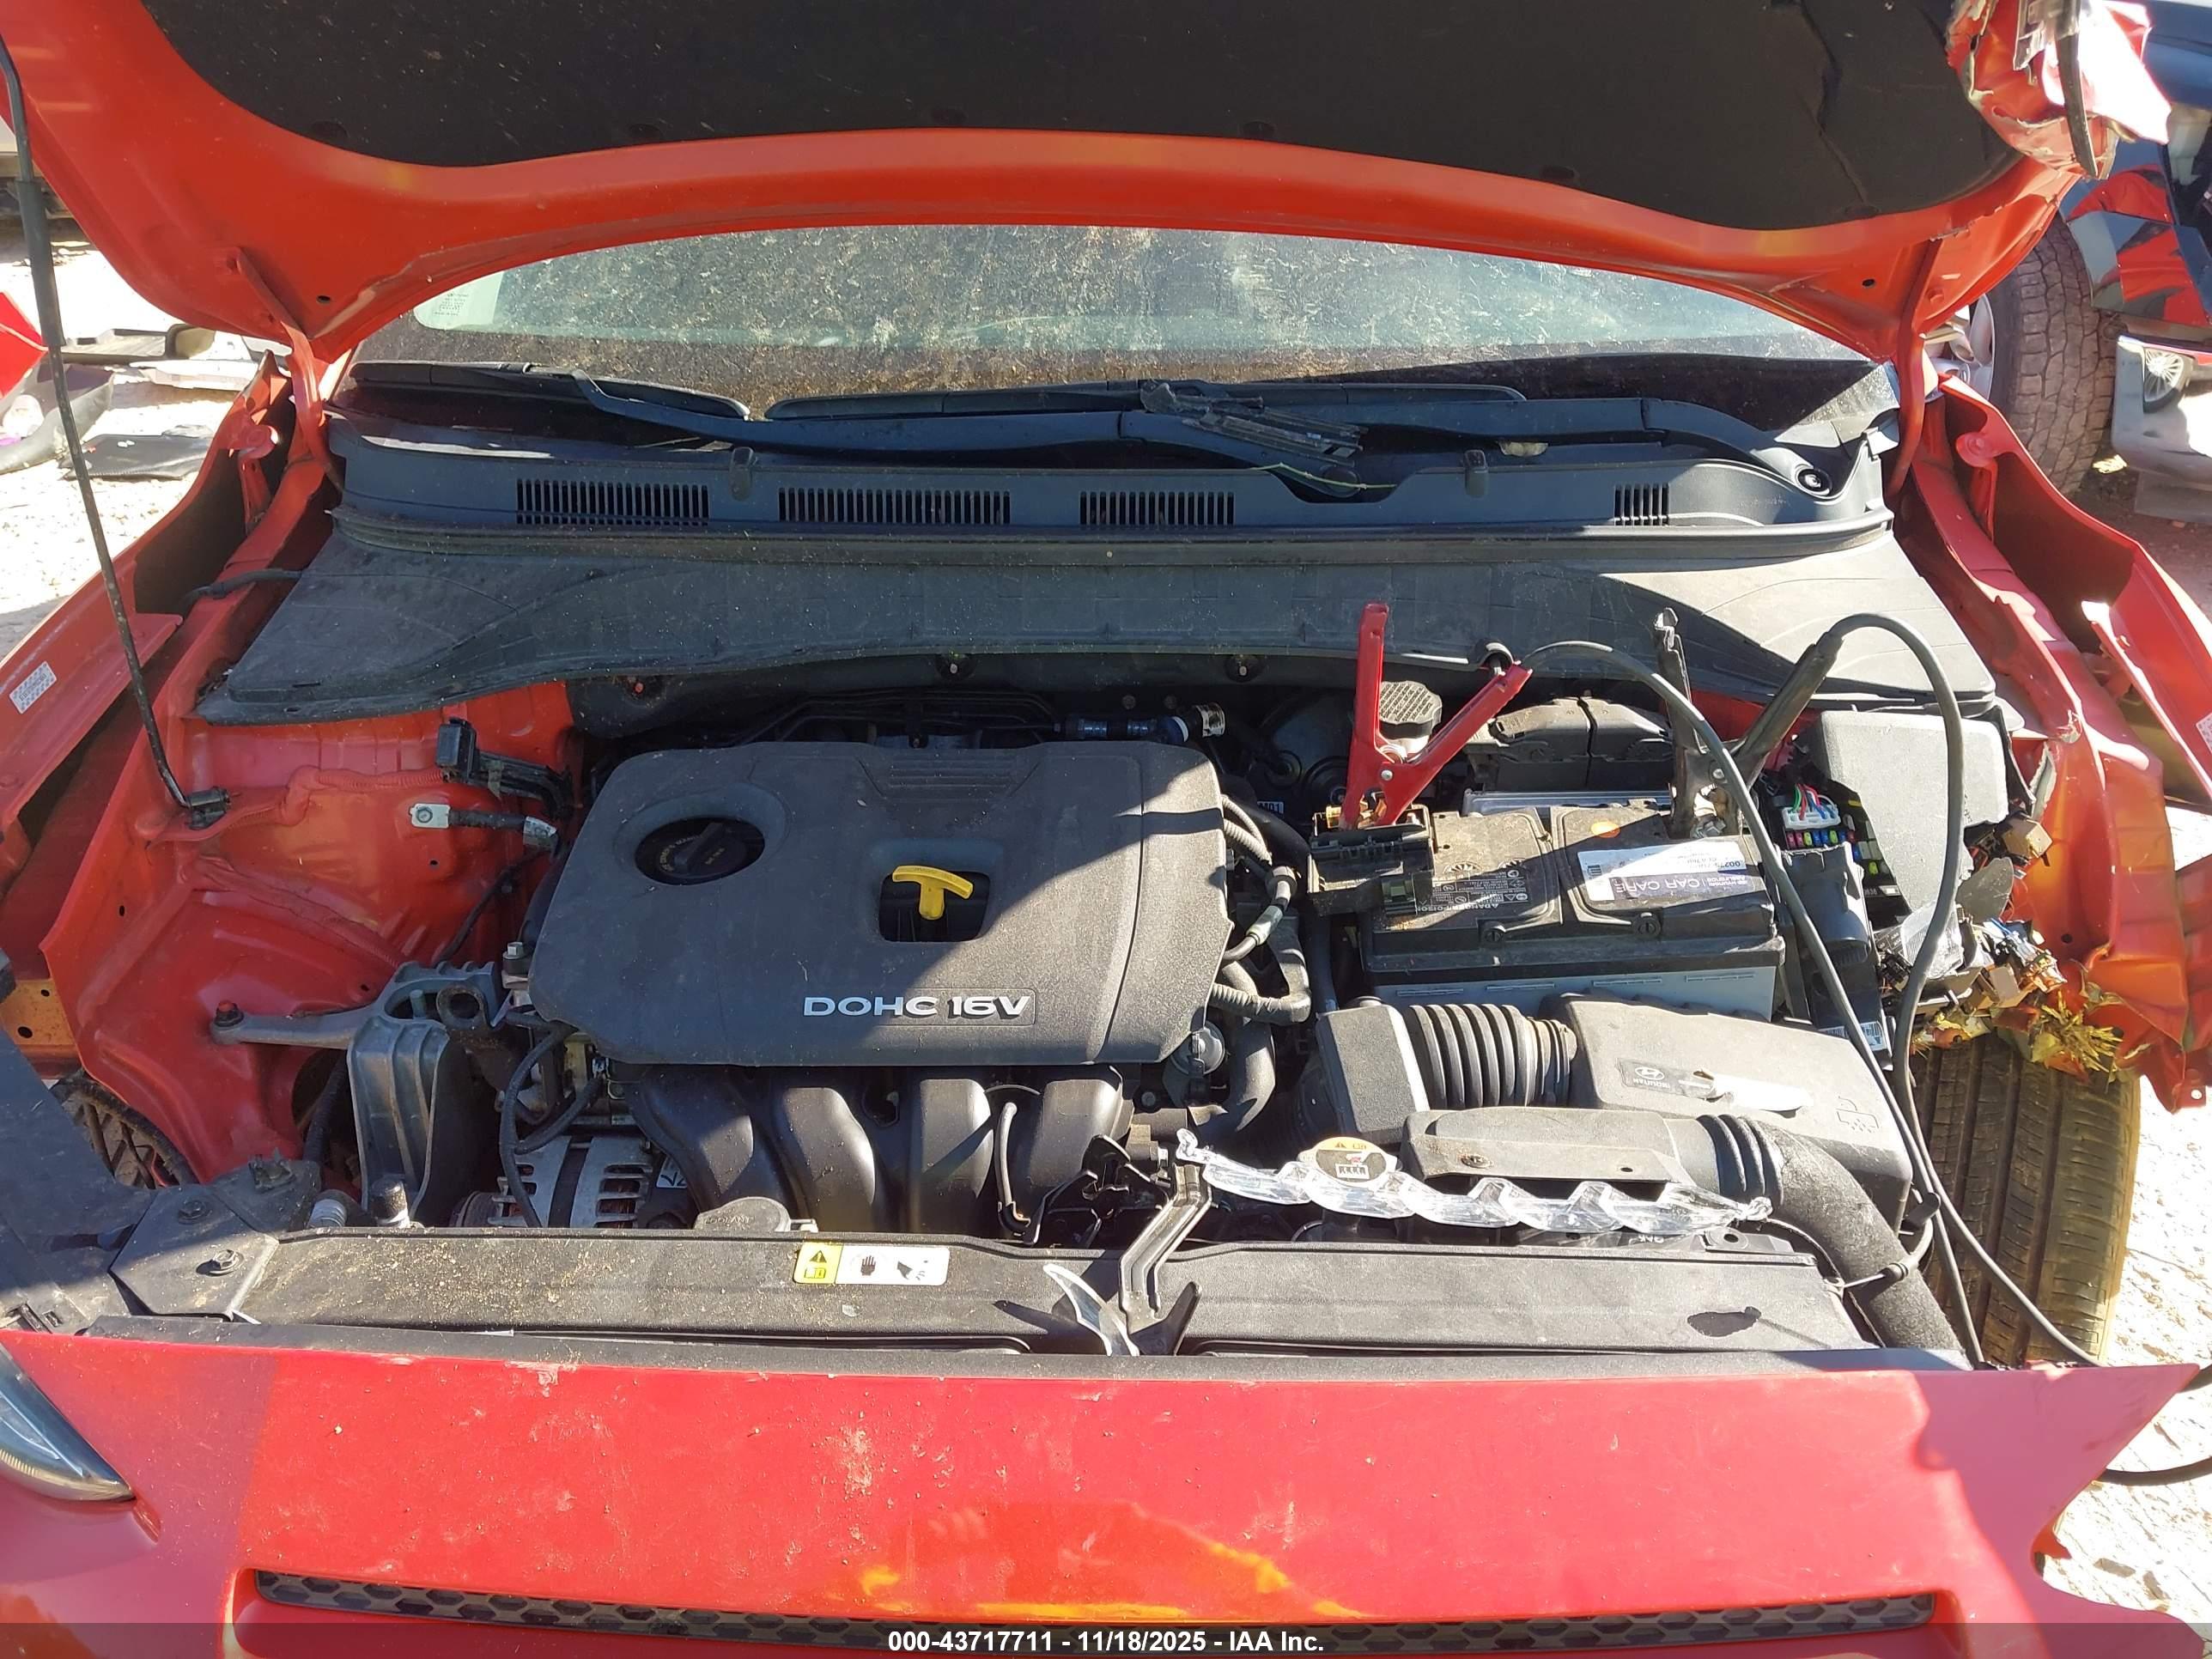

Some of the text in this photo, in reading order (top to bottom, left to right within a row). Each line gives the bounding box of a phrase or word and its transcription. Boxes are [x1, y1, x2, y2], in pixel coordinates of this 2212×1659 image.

[1613, 878, 1700, 893] CAR CARE
[803, 996, 1030, 1018] DOHC 16V
